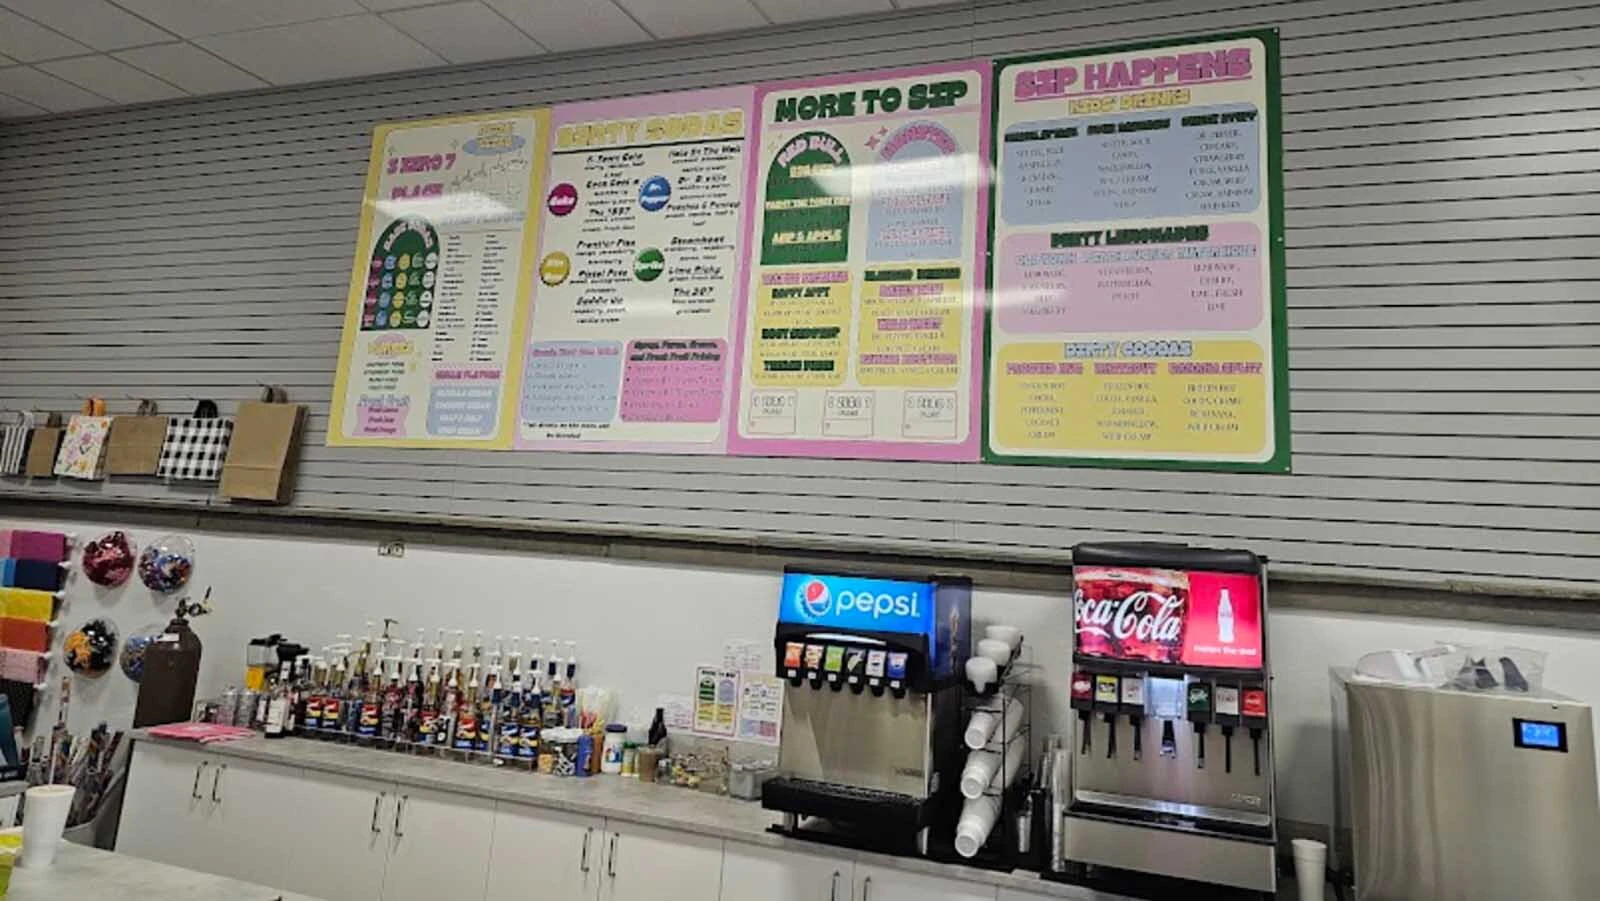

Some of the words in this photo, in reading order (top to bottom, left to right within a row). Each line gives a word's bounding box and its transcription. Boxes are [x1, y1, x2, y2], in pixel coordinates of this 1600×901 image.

[1083, 48, 1253, 91] HAPPENS
[775, 91, 856, 122] MORE
[863, 87, 902, 114] TO
[777, 138, 807, 167] RED
[809, 136, 845, 164] BULL
[835, 591, 919, 619] pepsi
